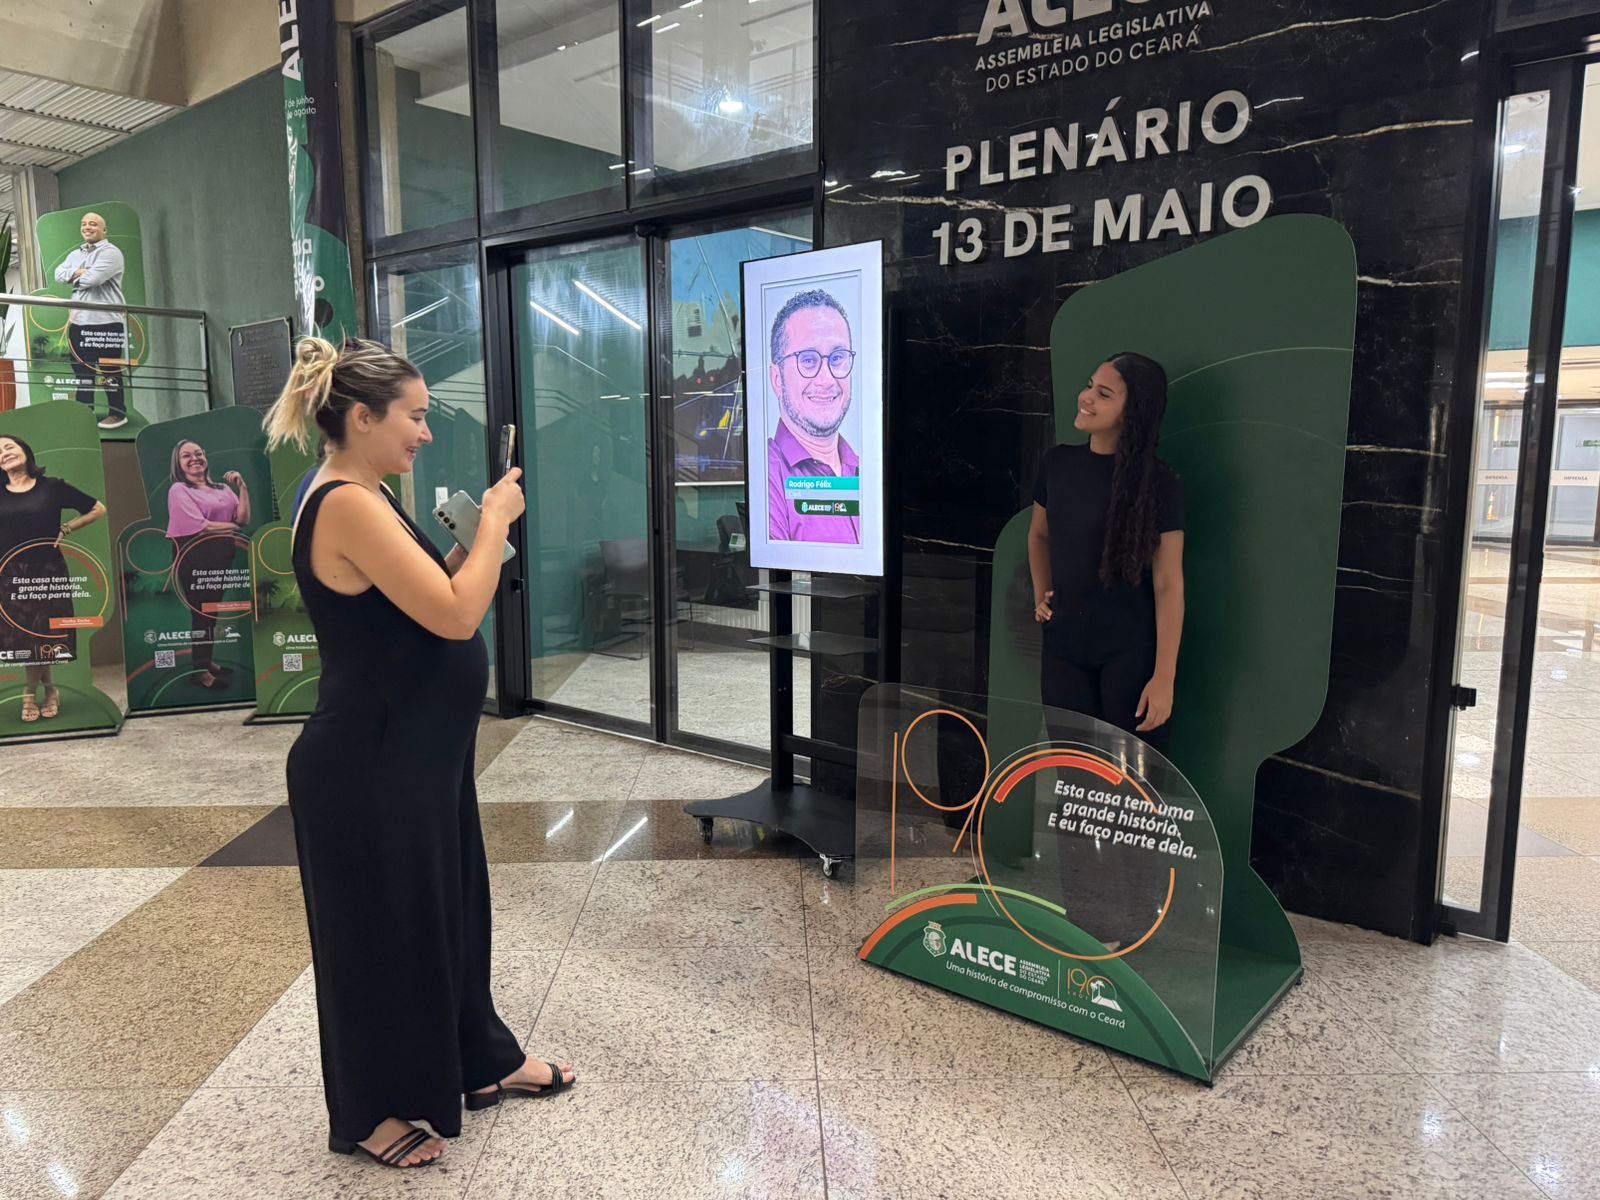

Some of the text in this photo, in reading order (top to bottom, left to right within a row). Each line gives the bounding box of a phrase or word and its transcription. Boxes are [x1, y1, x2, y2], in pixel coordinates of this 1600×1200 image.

[975, 33, 1082, 71] ASSEMBLEIA
[1088, 3, 1211, 46] LEGISLATIVA
[986, 24, 1200, 92] DO ESTADO DO CEARÁ
[946, 90, 1250, 191] PLENÁRIO
[932, 174, 1273, 266] 13 DE MAIO
[788, 480, 832, 489] Rodrigo Félix
[12, 576, 30, 584] Esta
[18, 583, 83, 593] grande história.
[197, 576, 222, 584] grande
[206, 582, 222, 591] faço
[222, 582, 241, 590] parte
[29, 592, 47, 600] faço
[48, 592, 71, 600] parte
[158, 630, 192, 640] ALECE
[1054, 780, 1195, 822] Esta casa tem uma
[1062, 802, 1182, 838] grande história.
[1047, 812, 1198, 859] E eu faço parte dela.
[949, 938, 1017, 976] ALECE
[1019, 959, 1050, 972] ASSEMBLEIA
[1019, 963, 1051, 977] LEGISLATIVA
[945, 960, 965, 974] Uma
[966, 966, 997, 985] história
[997, 979, 1008, 990] de
[1009, 984, 1067, 1009] compromisso
[1068, 1003, 1088, 1016] com
[1089, 1011, 1097, 1019] o
[1097, 1012, 1126, 1029] Ceará
